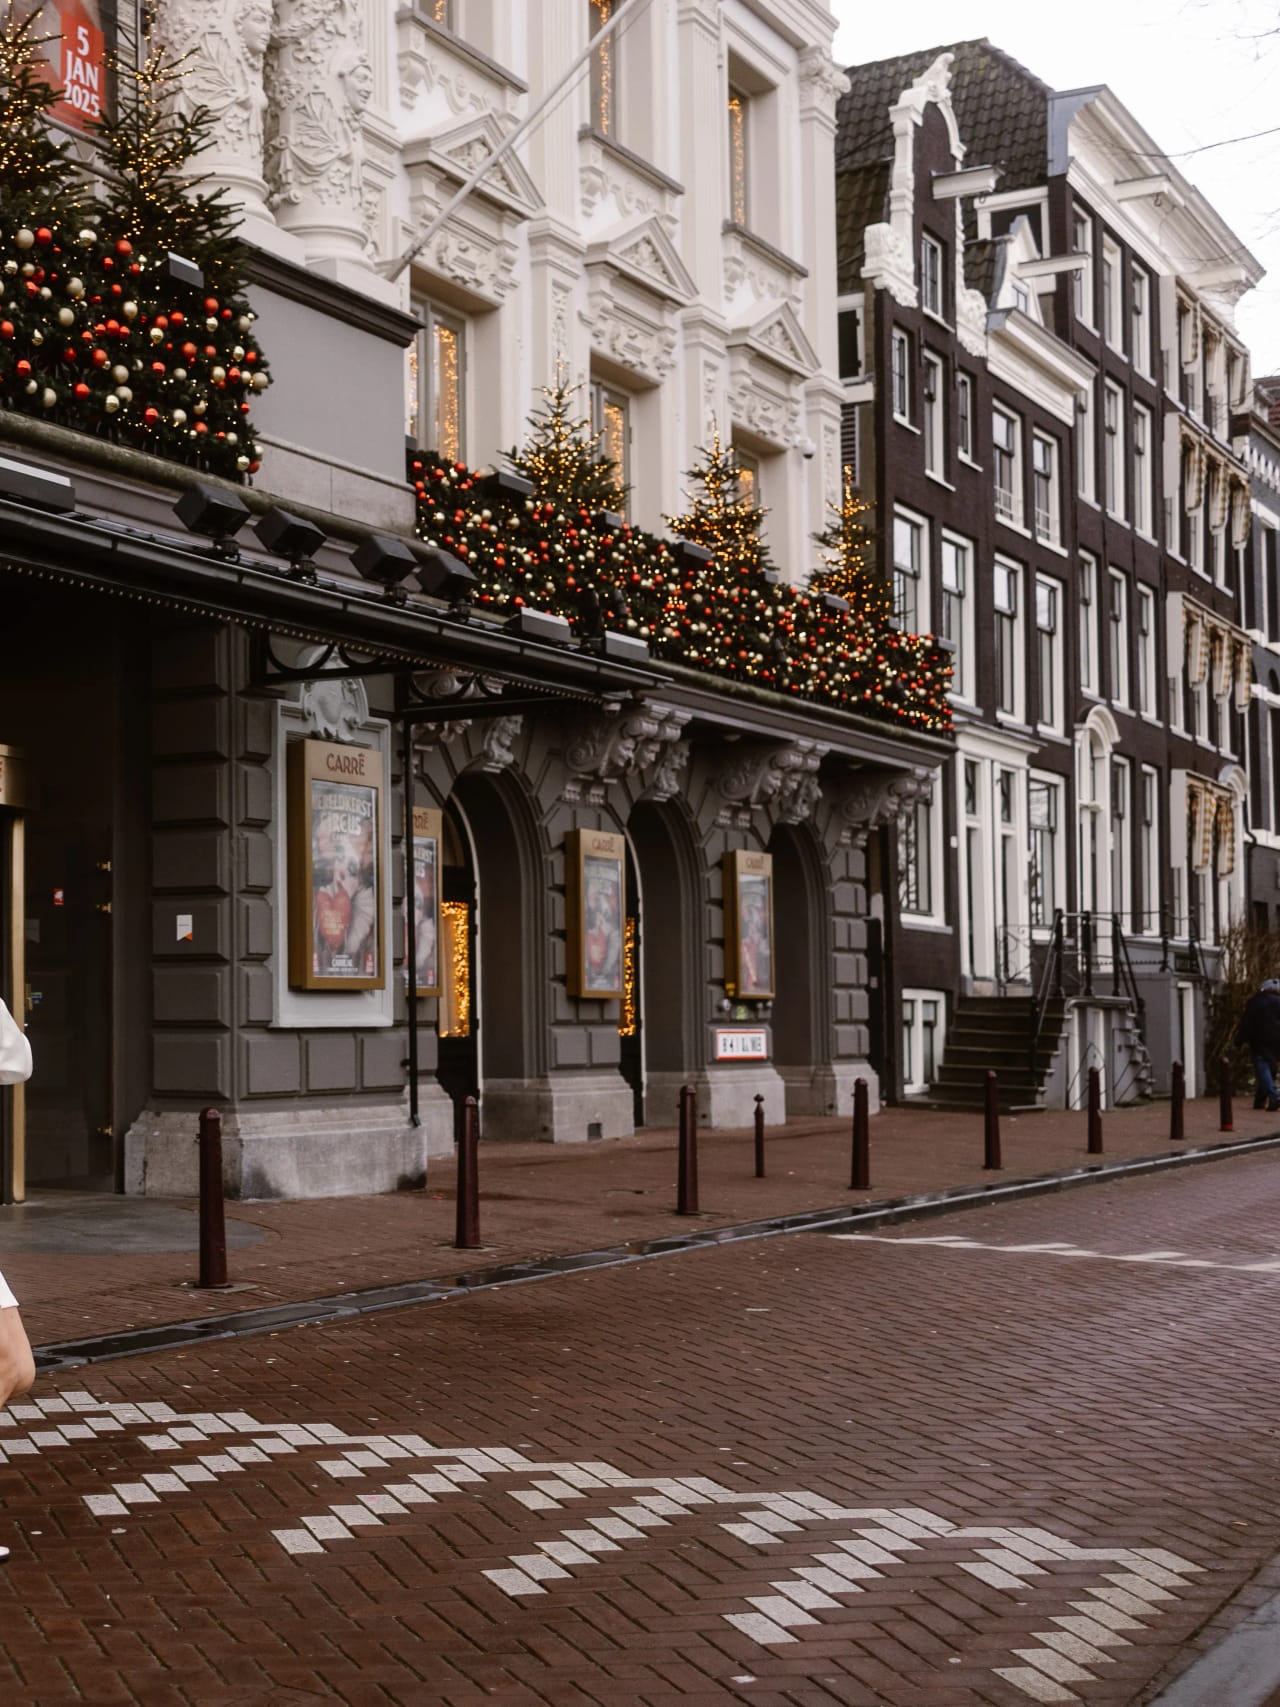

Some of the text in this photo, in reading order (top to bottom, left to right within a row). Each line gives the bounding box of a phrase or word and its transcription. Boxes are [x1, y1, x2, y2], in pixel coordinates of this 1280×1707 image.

[77, 25, 89, 56] 5
[65, 49, 98, 91] JAN
[63, 80, 100, 117] 2025
